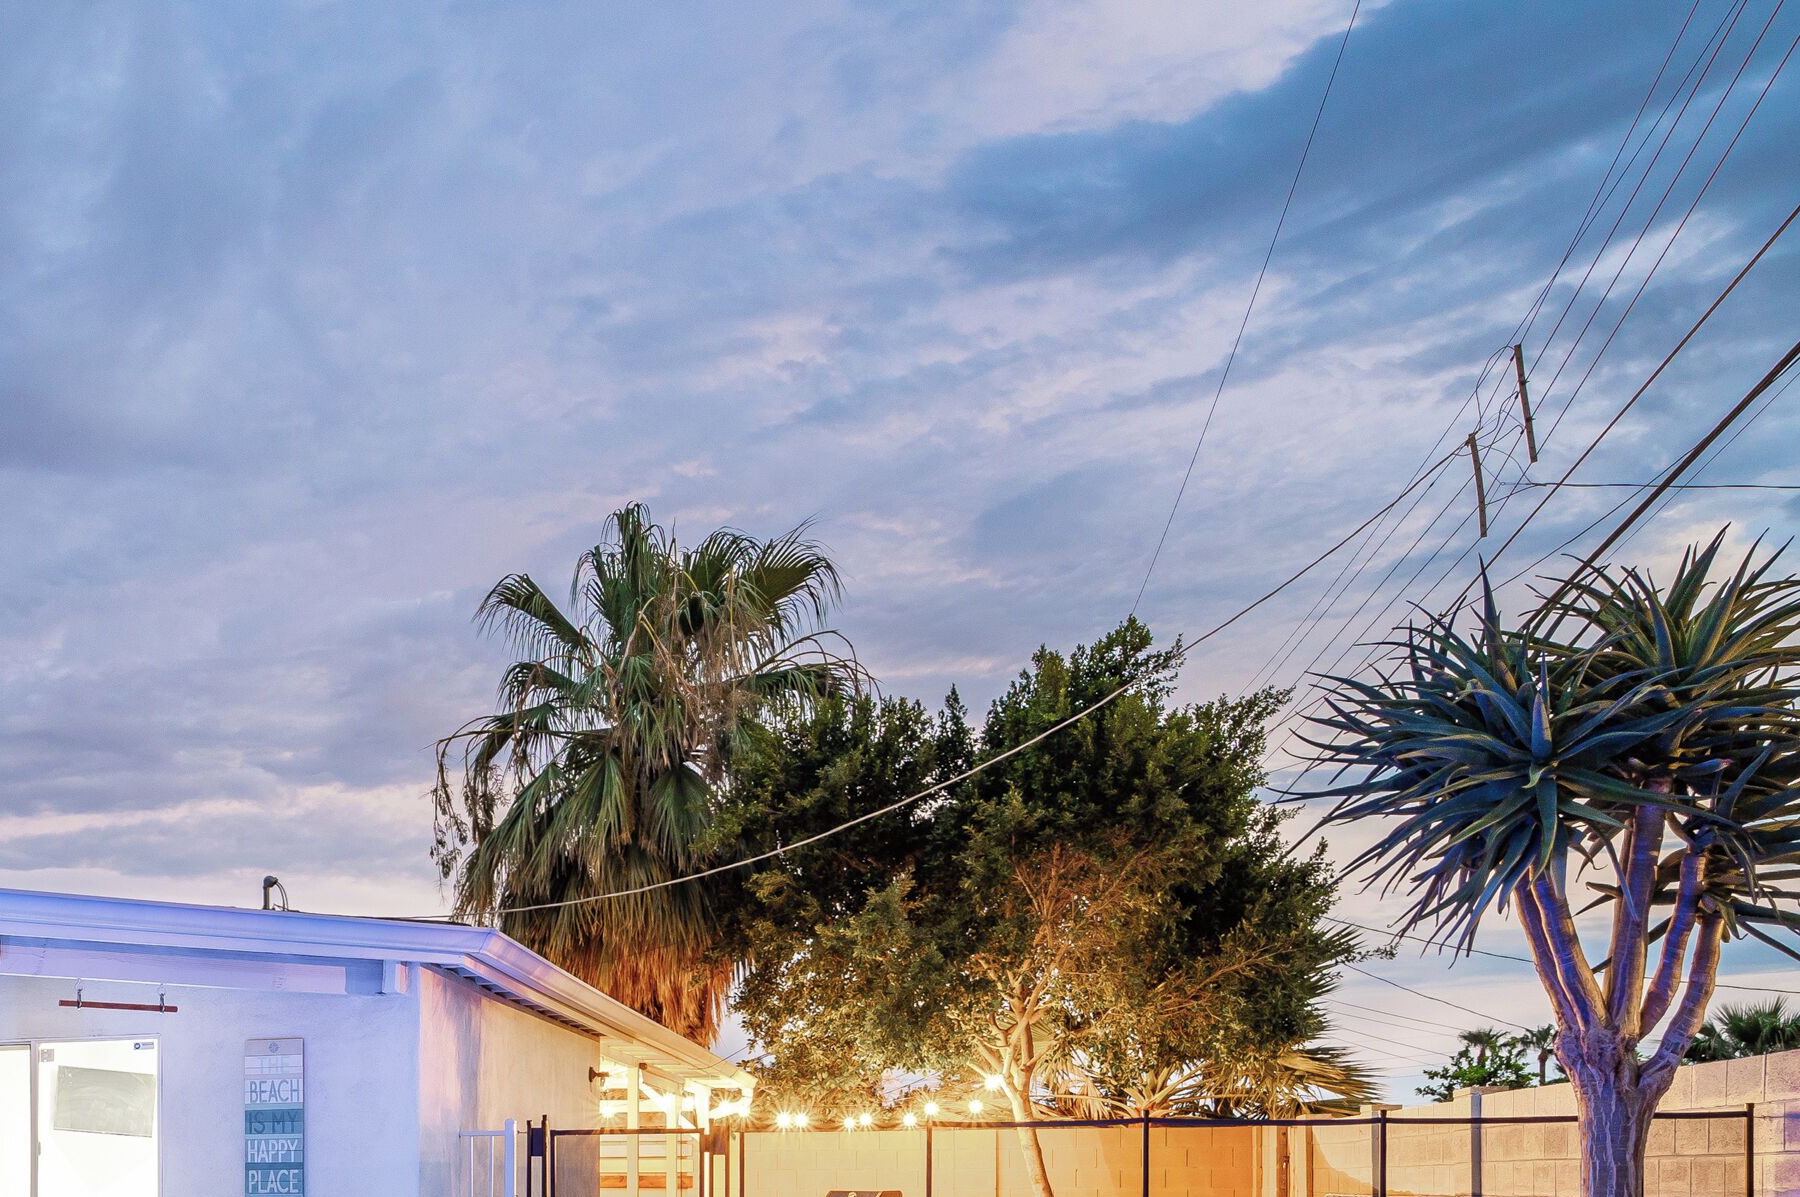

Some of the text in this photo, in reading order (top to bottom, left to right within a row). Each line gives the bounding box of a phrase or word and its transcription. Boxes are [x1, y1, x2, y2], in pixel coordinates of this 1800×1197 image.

[257, 1056, 291, 1074] THE
[249, 1079, 300, 1103] BEACH
[248, 1110, 298, 1134] IS MY
[247, 1139, 298, 1163] HAPPY
[248, 1169, 299, 1194] PLACE
